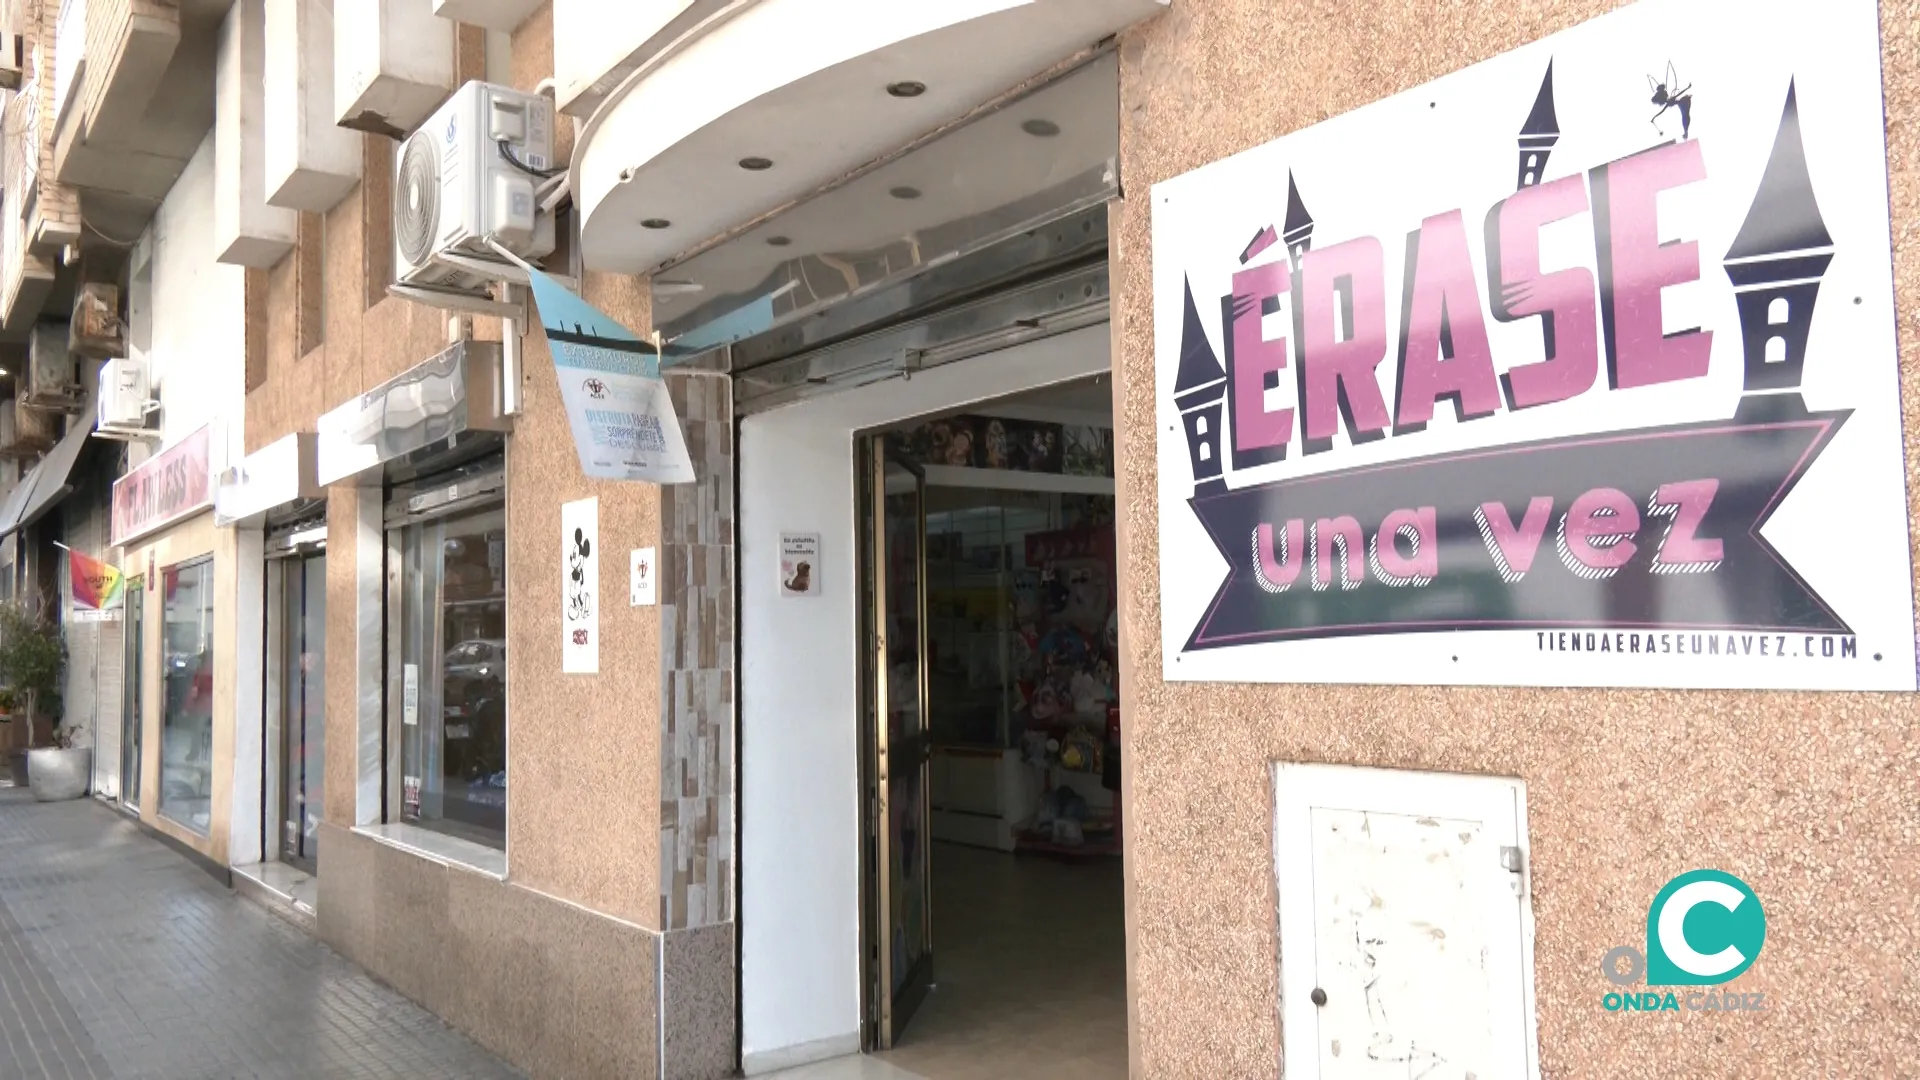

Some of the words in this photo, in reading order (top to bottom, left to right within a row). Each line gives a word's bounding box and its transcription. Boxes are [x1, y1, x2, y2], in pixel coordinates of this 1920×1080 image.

[1221, 138, 1713, 471] ÉRASE
[1252, 505, 1438, 593] una
[1473, 479, 1725, 583] vez
[1537, 632, 1857, 658] TIENDAERASEUNAVEZ.COM
